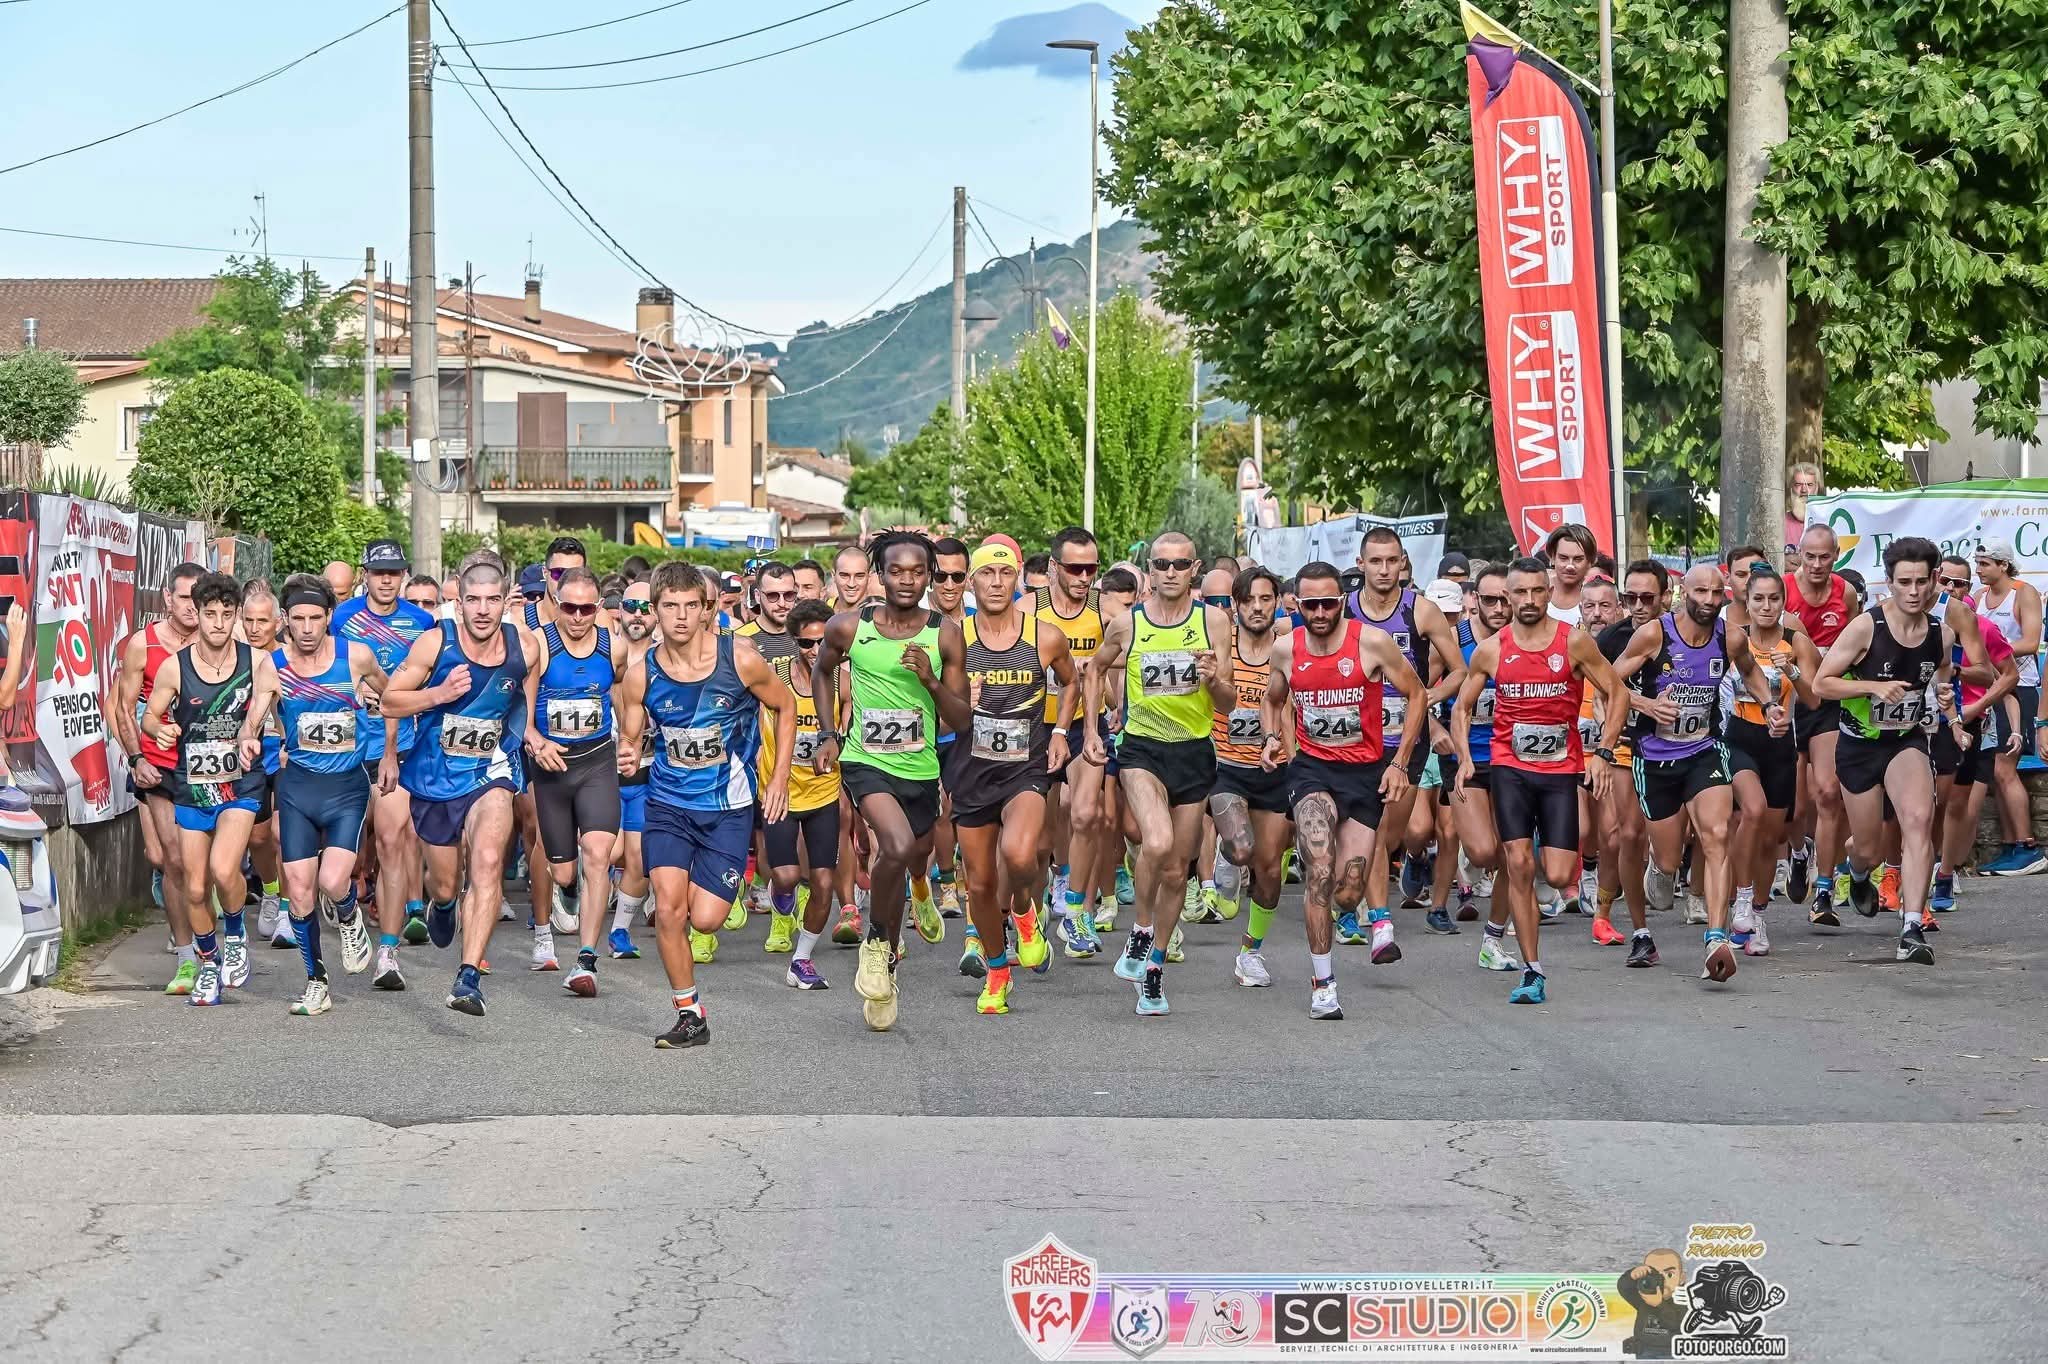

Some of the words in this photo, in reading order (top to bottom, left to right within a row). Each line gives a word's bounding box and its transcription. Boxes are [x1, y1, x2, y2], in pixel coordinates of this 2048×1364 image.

[1501, 130, 1543, 279] WHY
[1546, 153, 1566, 246] SPORT
[1513, 325, 1557, 471] WHY
[1558, 348, 1578, 441] SPORT
[1398, 521, 1435, 538] FITNESS
[1144, 663, 1199, 687] 214
[1294, 690, 1315, 706] FREE
[1317, 686, 1364, 705] RUNNERS
[1523, 681, 1568, 697] RUNNERS
[551, 710, 600, 731] 114
[1873, 701, 1919, 722] 147
[308, 724, 345, 745] 43
[445, 726, 497, 751] 146
[865, 721, 918, 745] 221
[1313, 717, 1349, 738] 24
[668, 737, 721, 761] 145
[991, 731, 1008, 753] 8
[1522, 735, 1557, 755] 22
[190, 751, 238, 776] 230
